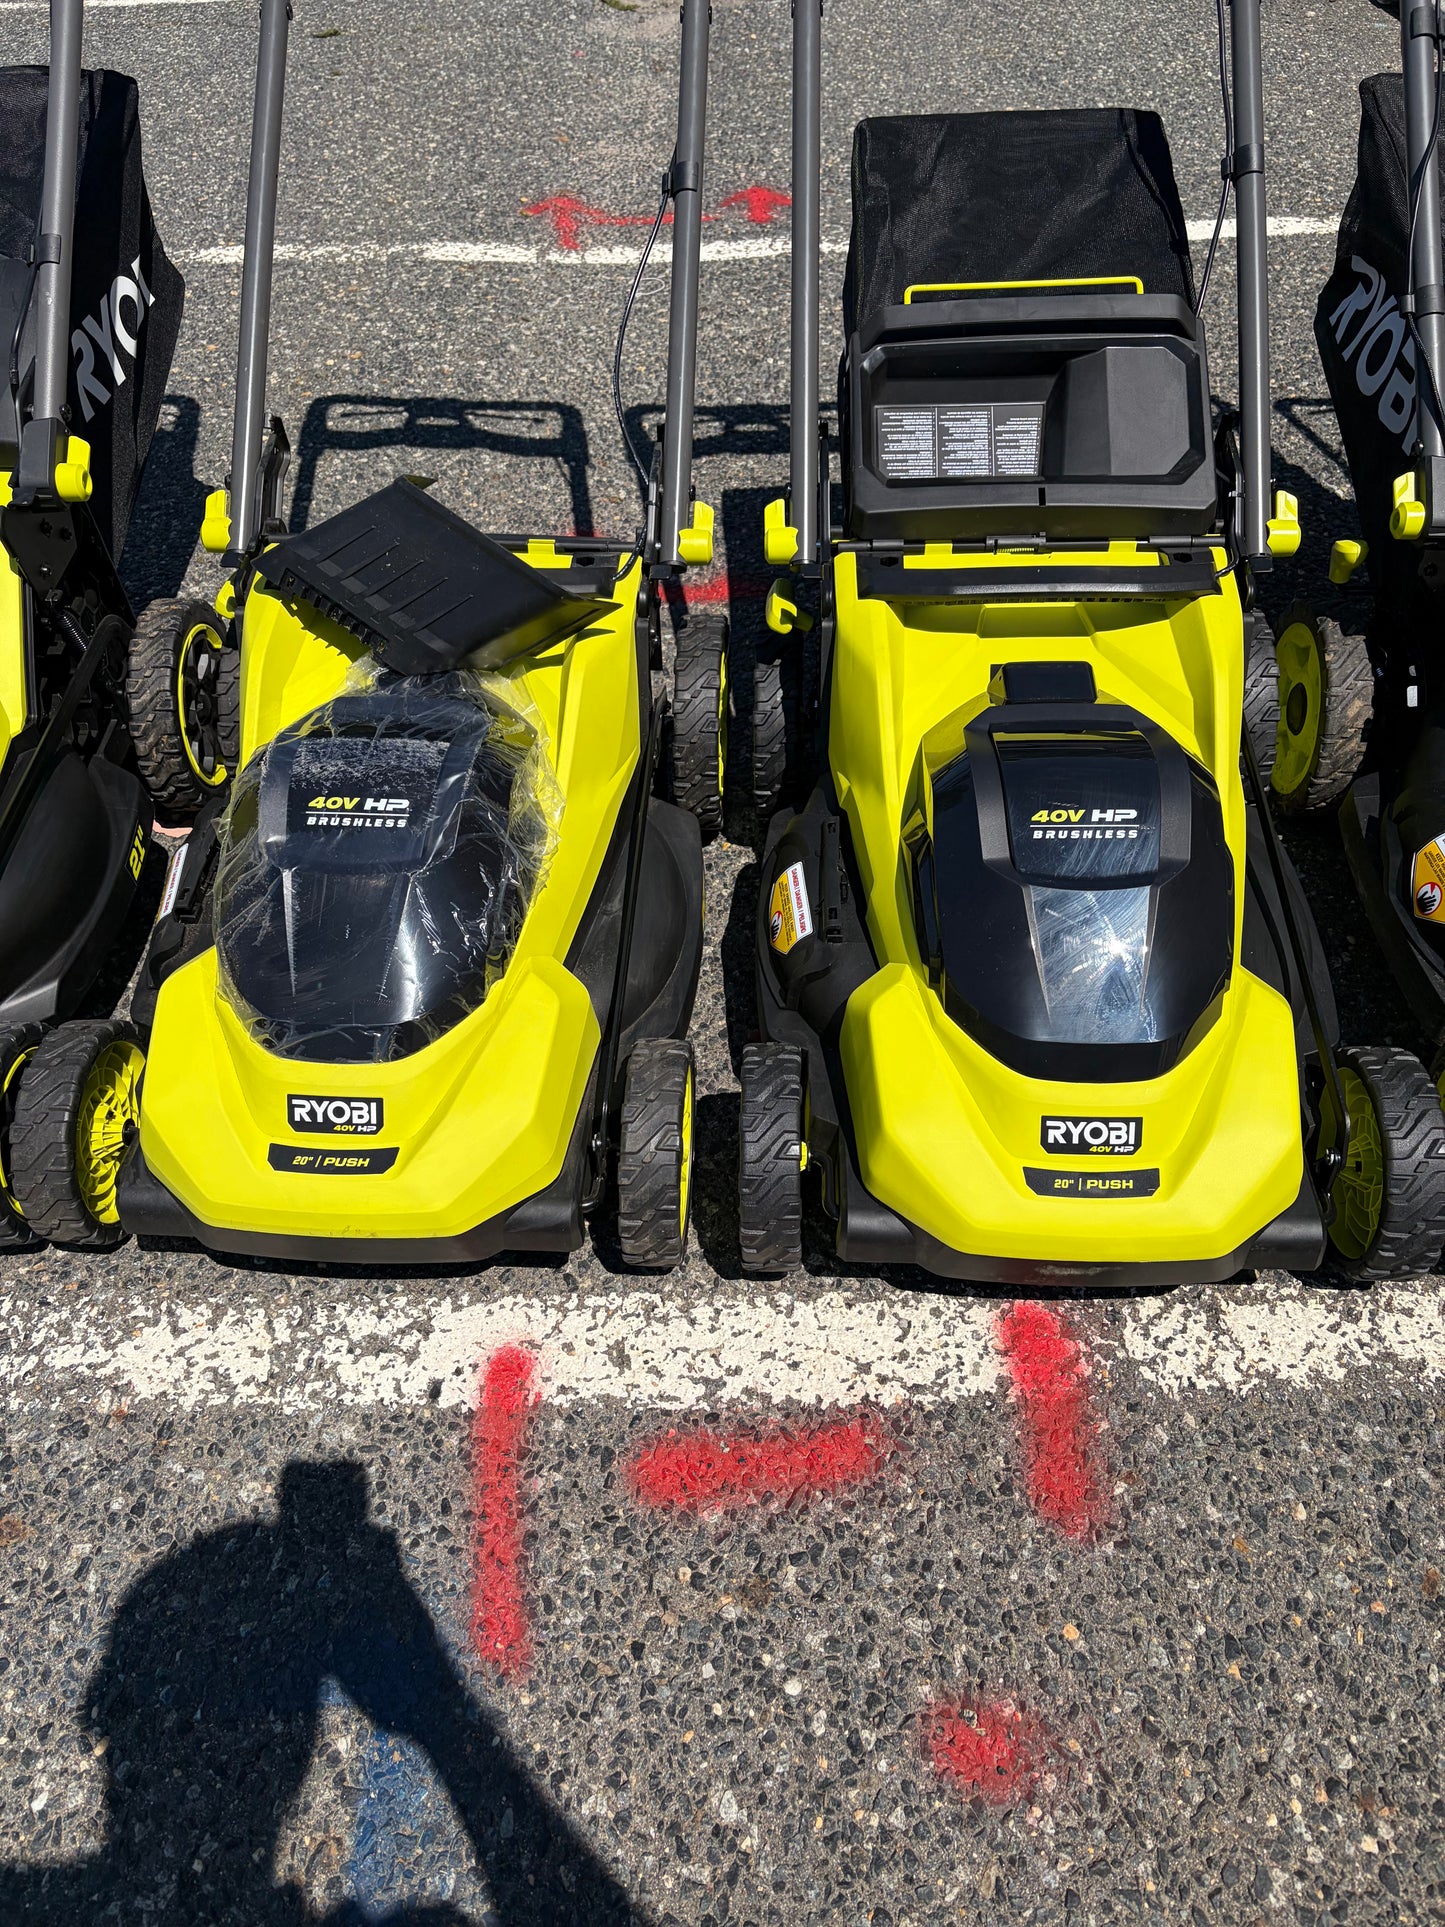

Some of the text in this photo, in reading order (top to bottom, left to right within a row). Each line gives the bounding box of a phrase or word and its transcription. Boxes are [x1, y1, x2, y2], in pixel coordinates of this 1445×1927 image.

[308, 796, 410, 811] 40V HP
[306, 816, 407, 828] BRUSHLESS
[1031, 809, 1137, 823] 40V HP
[1032, 829, 1138, 839] BRUSHLESS
[291, 1098, 377, 1125] RYOBI
[333, 1124, 355, 1132] 40V
[1046, 1120, 1136, 1145] RYOBI
[1089, 1145, 1135, 1153] 40V HP
[323, 1156, 371, 1168] PUSH
[1086, 1178, 1134, 1190] PUSH
